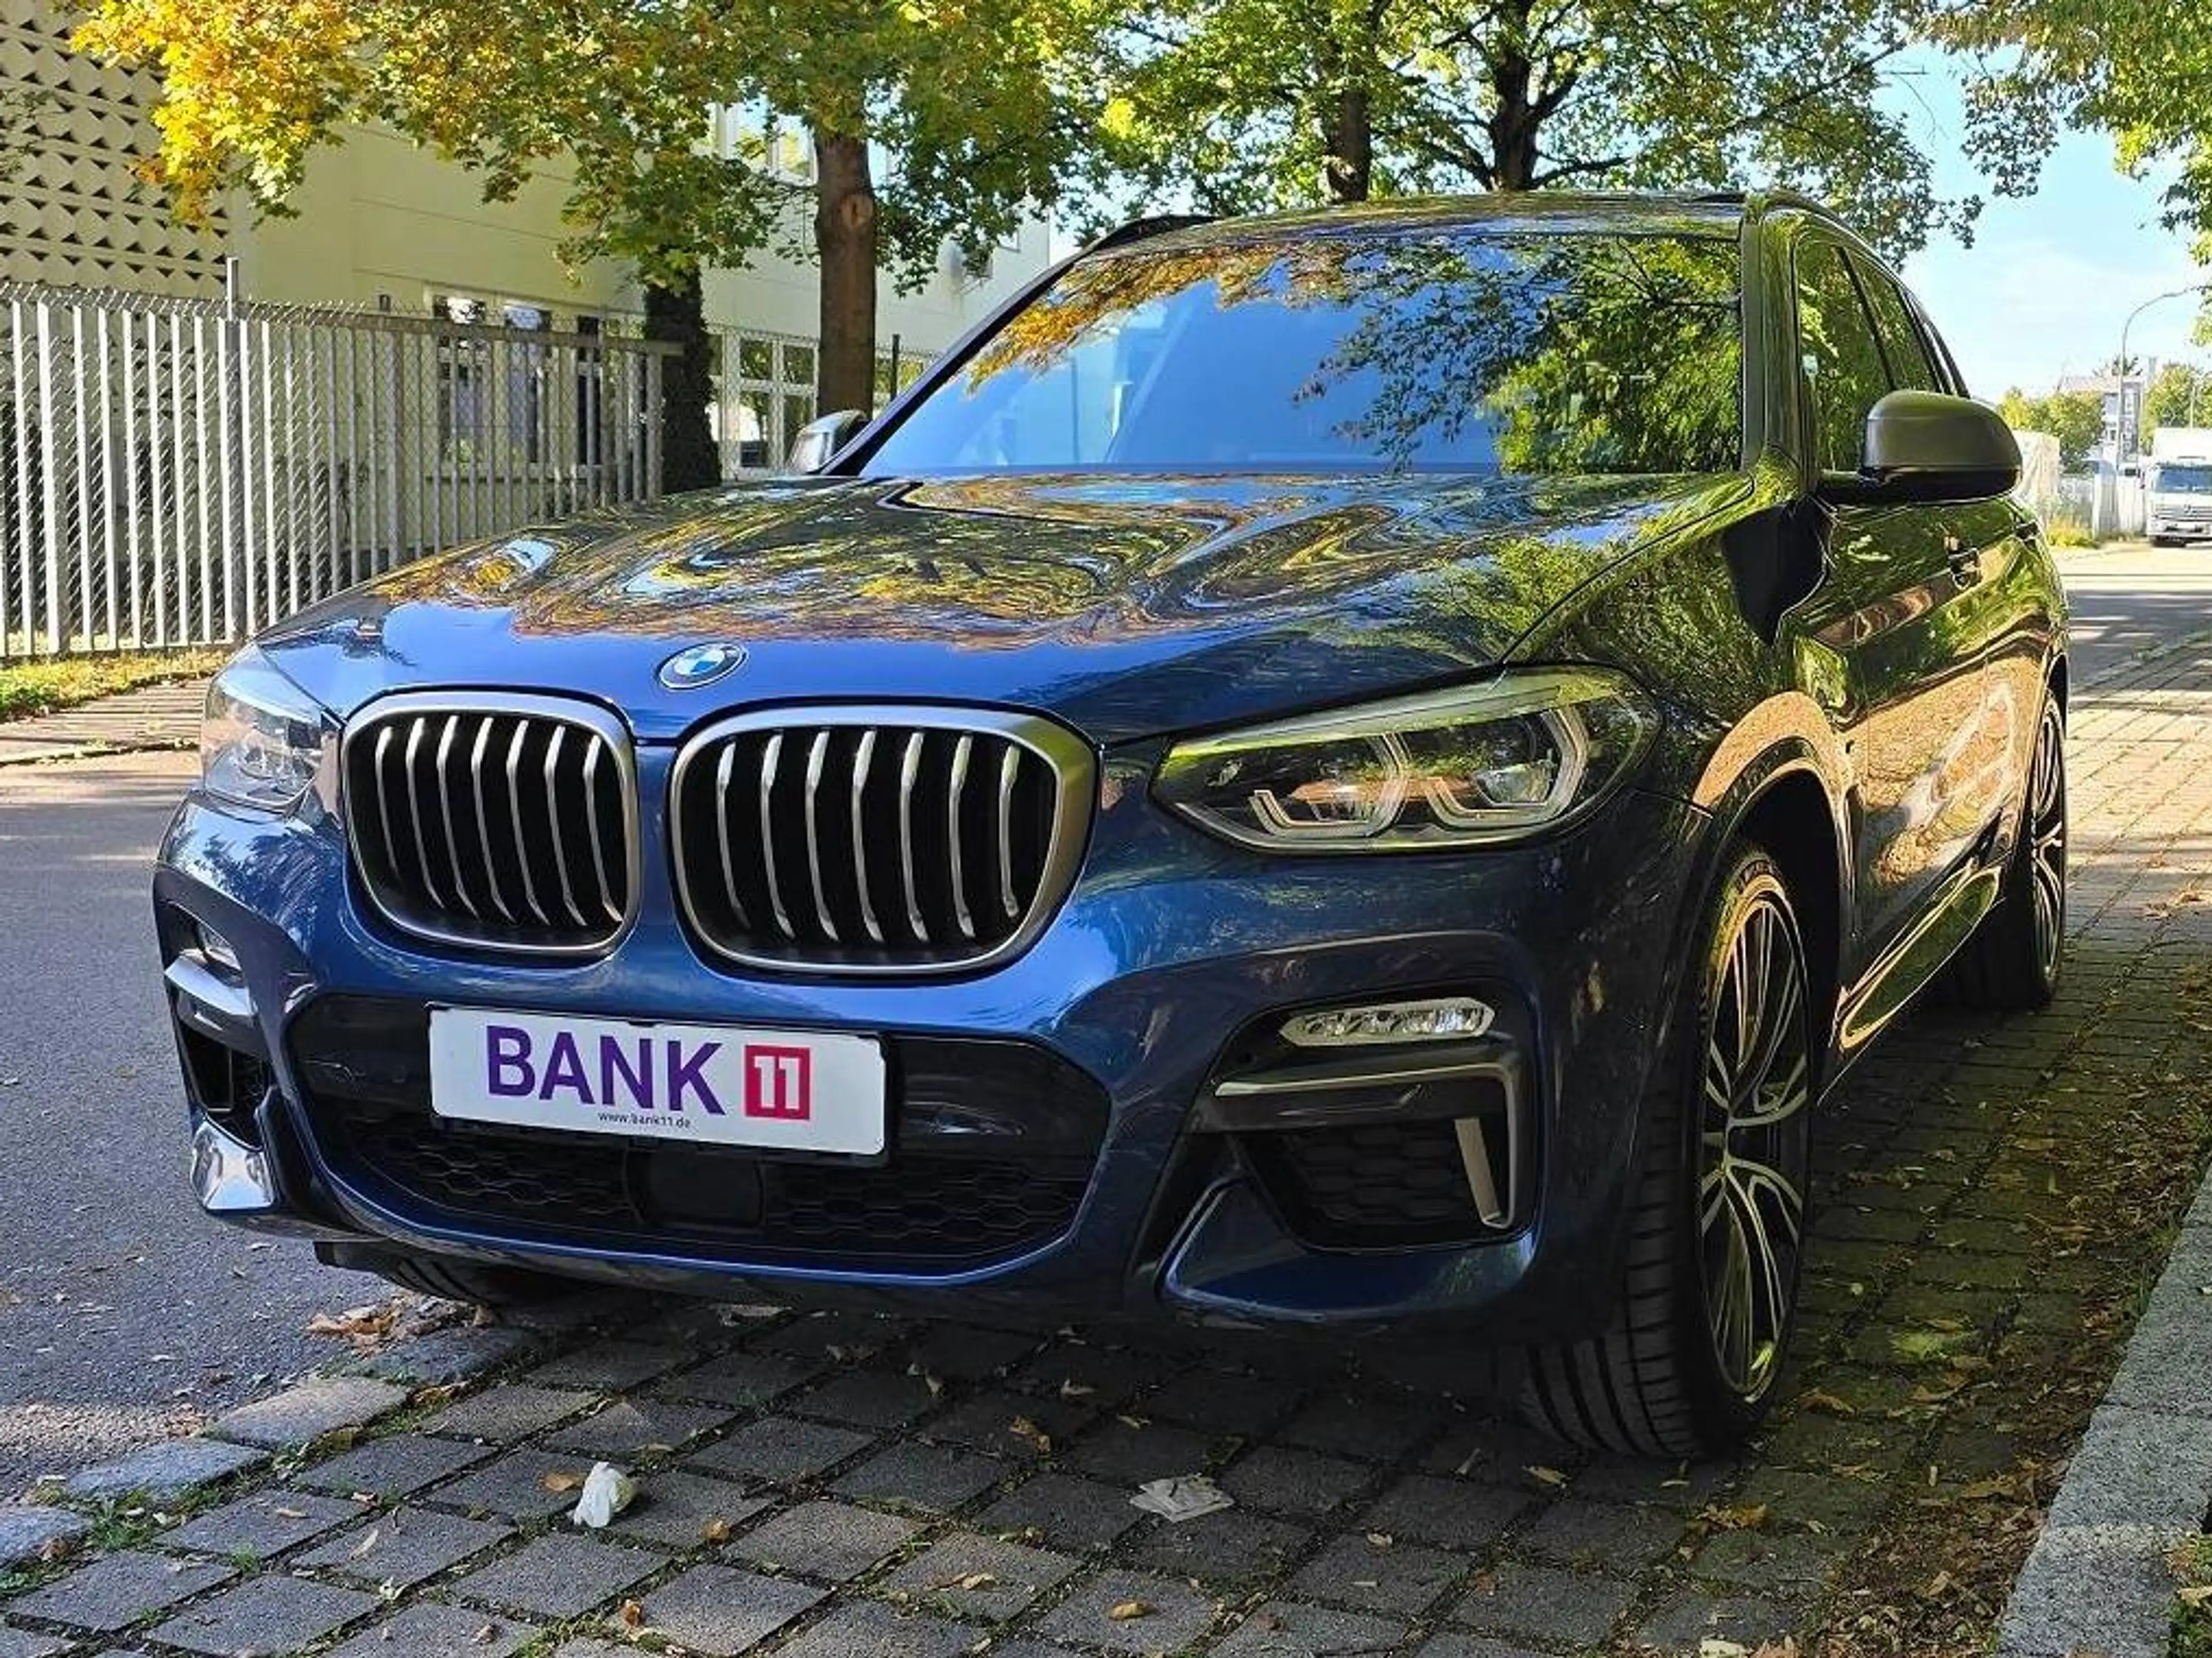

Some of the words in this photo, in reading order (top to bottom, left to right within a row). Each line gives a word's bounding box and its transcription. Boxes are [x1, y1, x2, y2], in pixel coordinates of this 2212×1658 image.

[486, 1025, 726, 1115] BANK
[753, 1055, 801, 1110] 11
[597, 1112, 691, 1128] www.bank11.de
